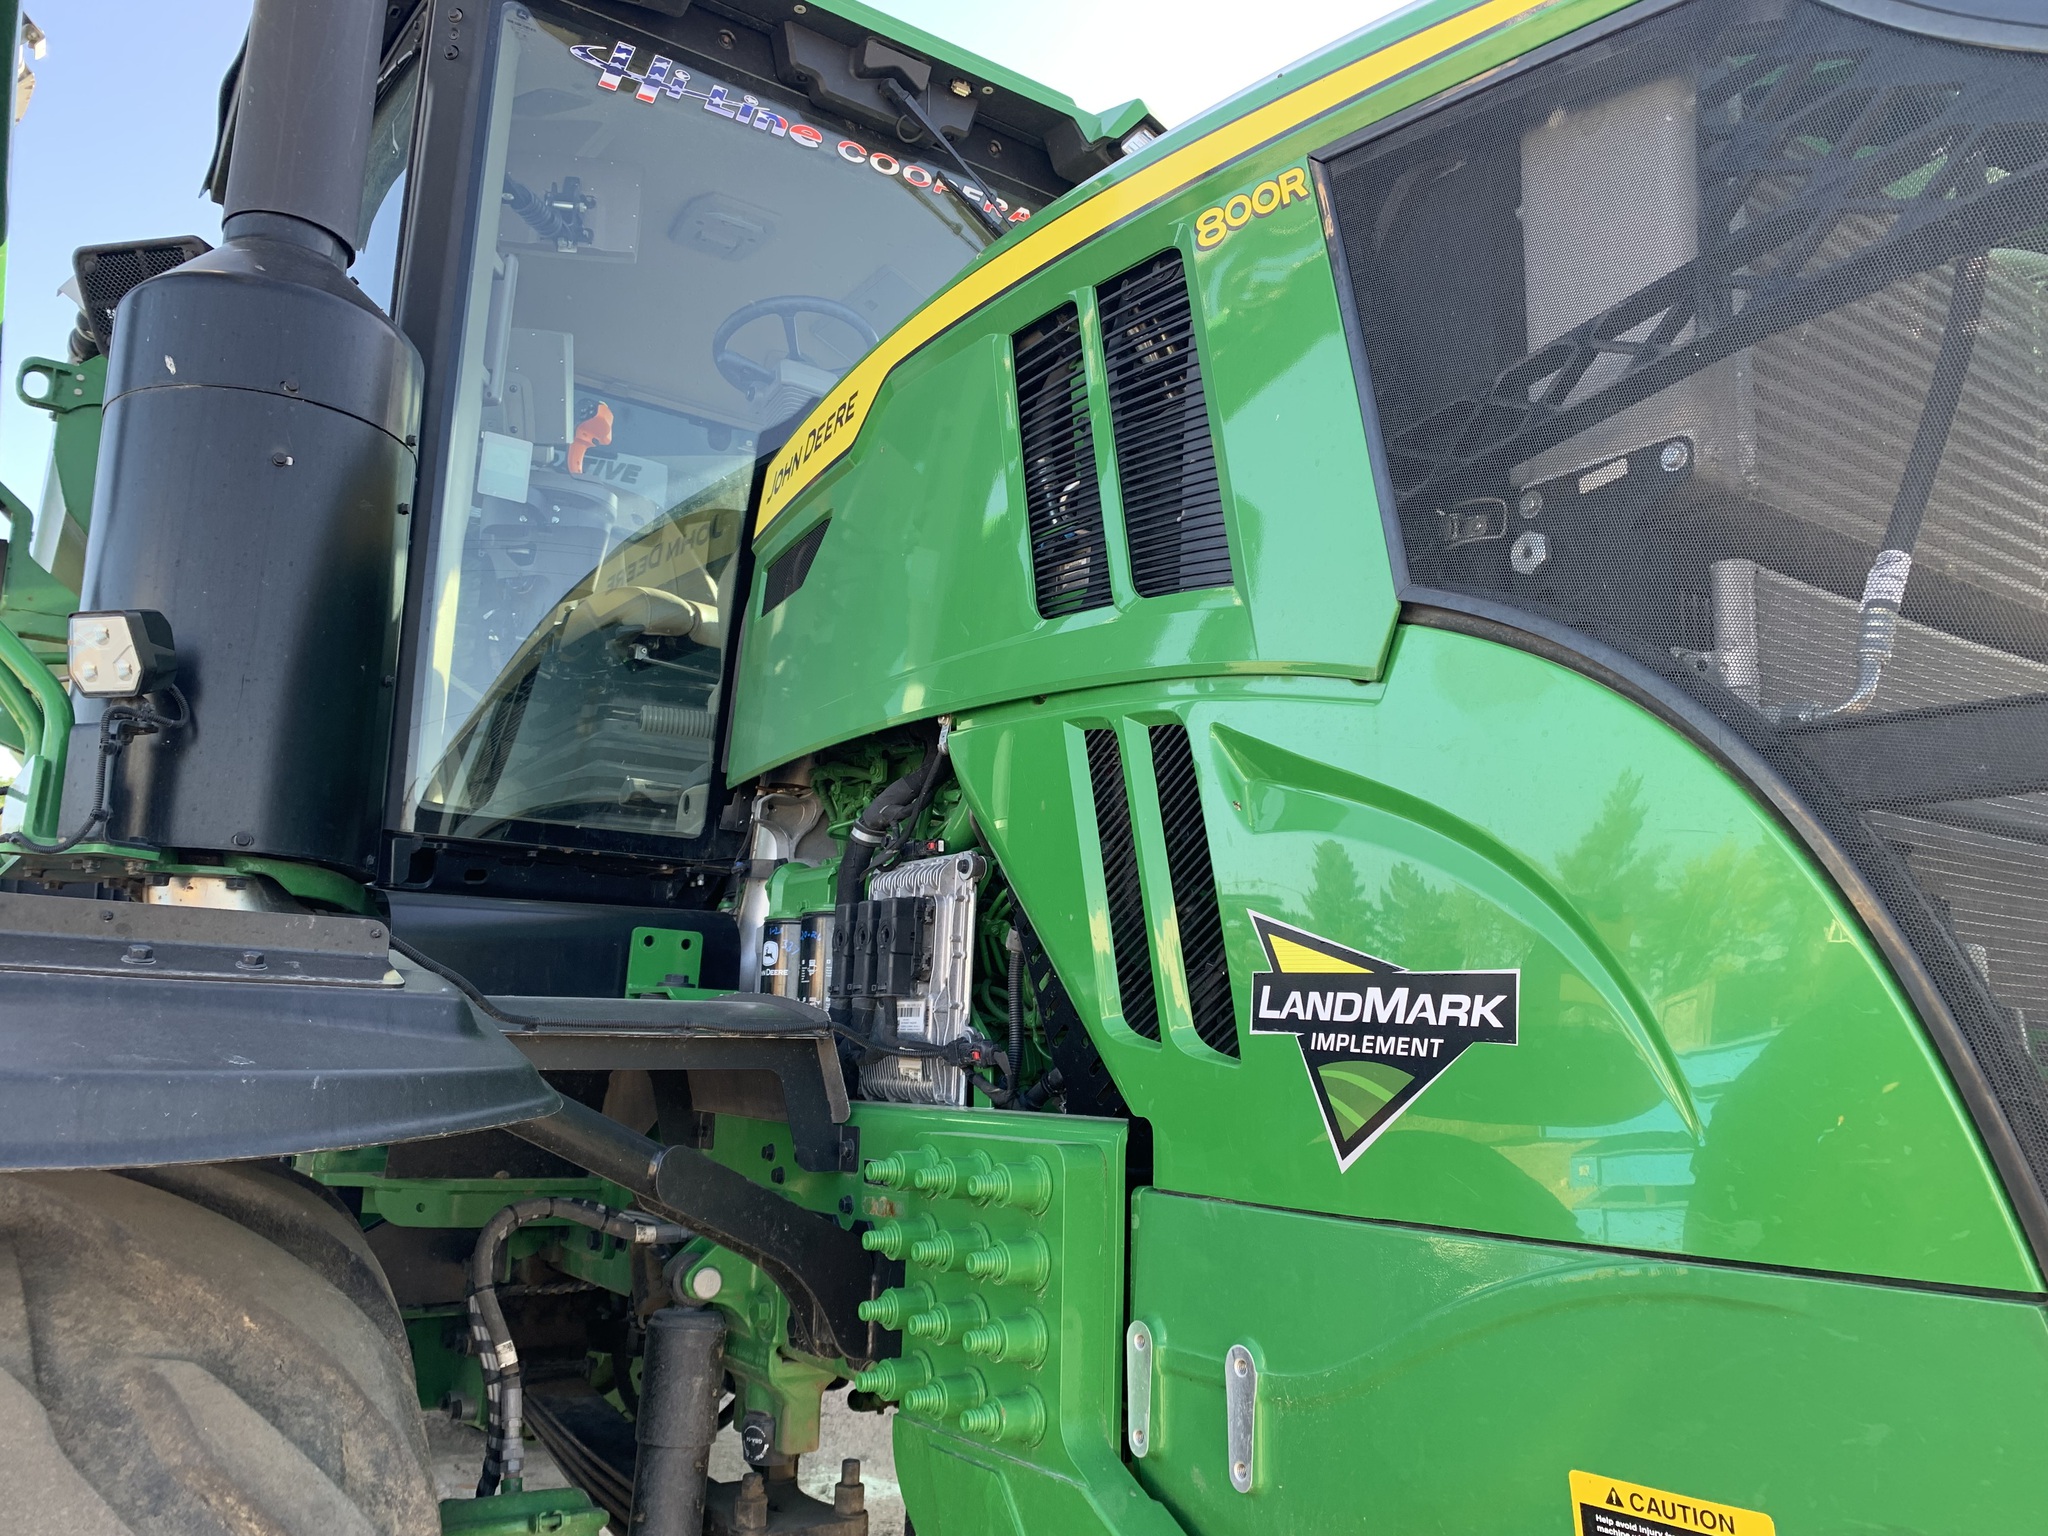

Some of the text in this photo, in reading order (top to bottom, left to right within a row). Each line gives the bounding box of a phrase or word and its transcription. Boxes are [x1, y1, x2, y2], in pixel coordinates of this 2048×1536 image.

[1195, 167, 1311, 251] 800R
[766, 390, 859, 504] JOHN DEERE
[766, 968, 789, 976] DEERE
[1258, 985, 1507, 1028] LANDMARK
[1310, 1032, 1444, 1058] IMPLEMENT
[1595, 1514, 1615, 1526] Help
[1615, 1520, 1637, 1532] avoid
[1629, 1493, 1736, 1535] CAUTION
